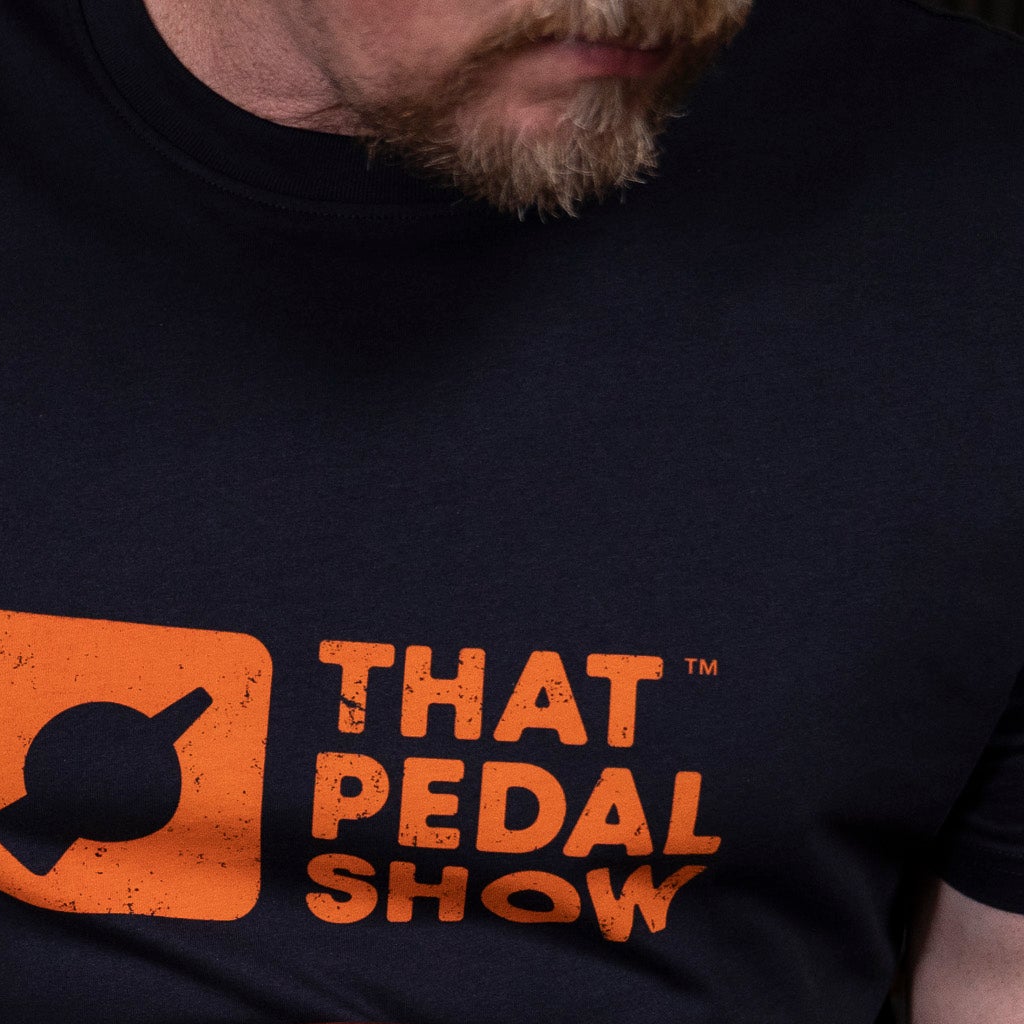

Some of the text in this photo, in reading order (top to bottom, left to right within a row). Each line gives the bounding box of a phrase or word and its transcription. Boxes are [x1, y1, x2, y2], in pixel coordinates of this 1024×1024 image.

[318, 639, 665, 749] THAT
[311, 751, 722, 858] PEDAL
[305, 852, 707, 943] SHOW
